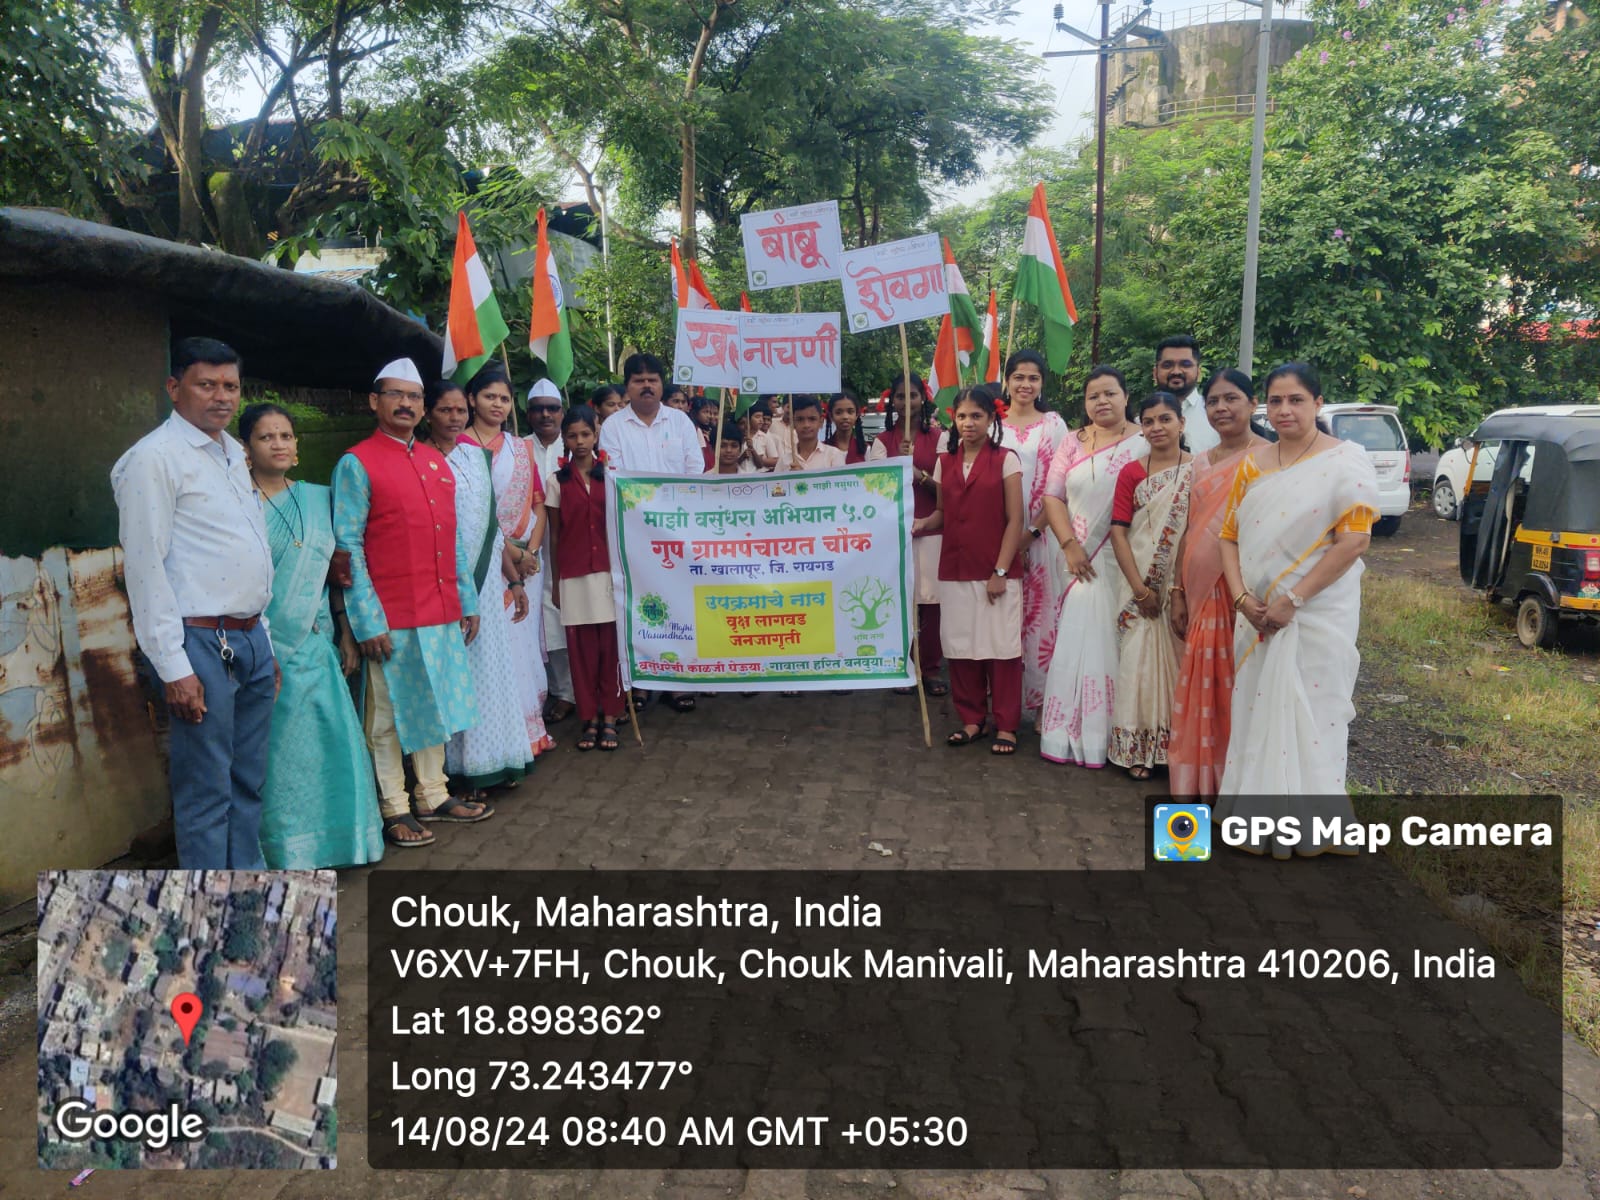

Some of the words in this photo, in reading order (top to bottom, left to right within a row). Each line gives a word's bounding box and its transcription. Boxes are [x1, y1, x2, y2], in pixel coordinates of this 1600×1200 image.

[743, 322, 838, 368] नाचणी
[643, 506, 690, 531] माझी
[694, 505, 756, 535] वसुंधरा
[763, 502, 837, 526] अभियान
[842, 503, 876, 523] ५.०
[691, 532, 817, 561] ग्रामपंचायत
[821, 527, 872, 554] चौक
[689, 564, 708, 577] ता.
[769, 559, 789, 575] जि.
[793, 560, 835, 573] रायगड
[704, 590, 785, 611] उपक्रमाचे
[789, 591, 826, 607] नाव
[726, 614, 750, 633] वृक्ष
[754, 612, 807, 628] लागवड
[729, 628, 801, 650] जनजागृती
[687, 661, 725, 673] काळजी
[813, 657, 841, 671] हरित
